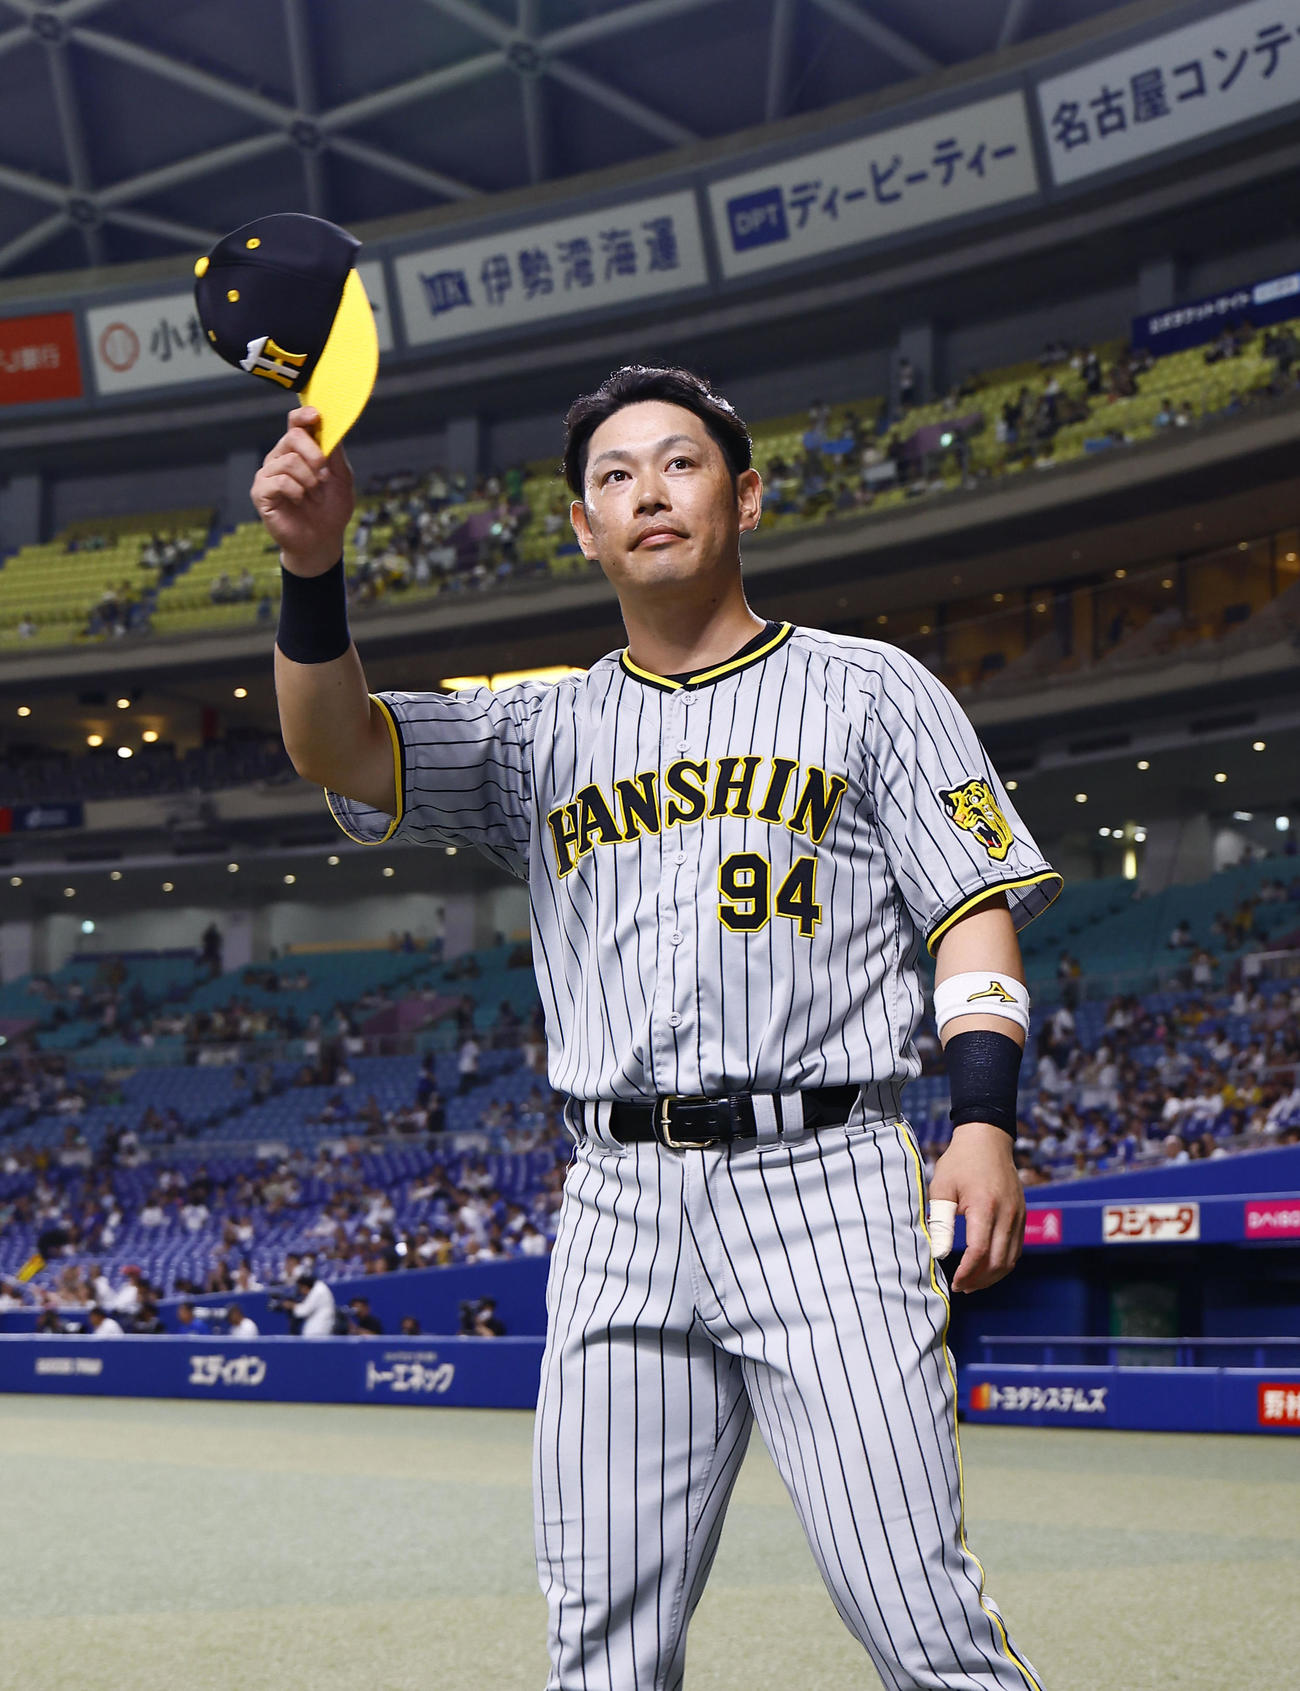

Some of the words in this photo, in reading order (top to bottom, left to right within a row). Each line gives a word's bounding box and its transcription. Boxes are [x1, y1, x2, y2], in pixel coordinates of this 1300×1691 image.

[1051, 21, 1300, 152] 名古屋コンテ
[734, 202, 779, 236] DPT
[547, 755, 848, 879] HANSHIN
[717, 851, 822, 939] 94
